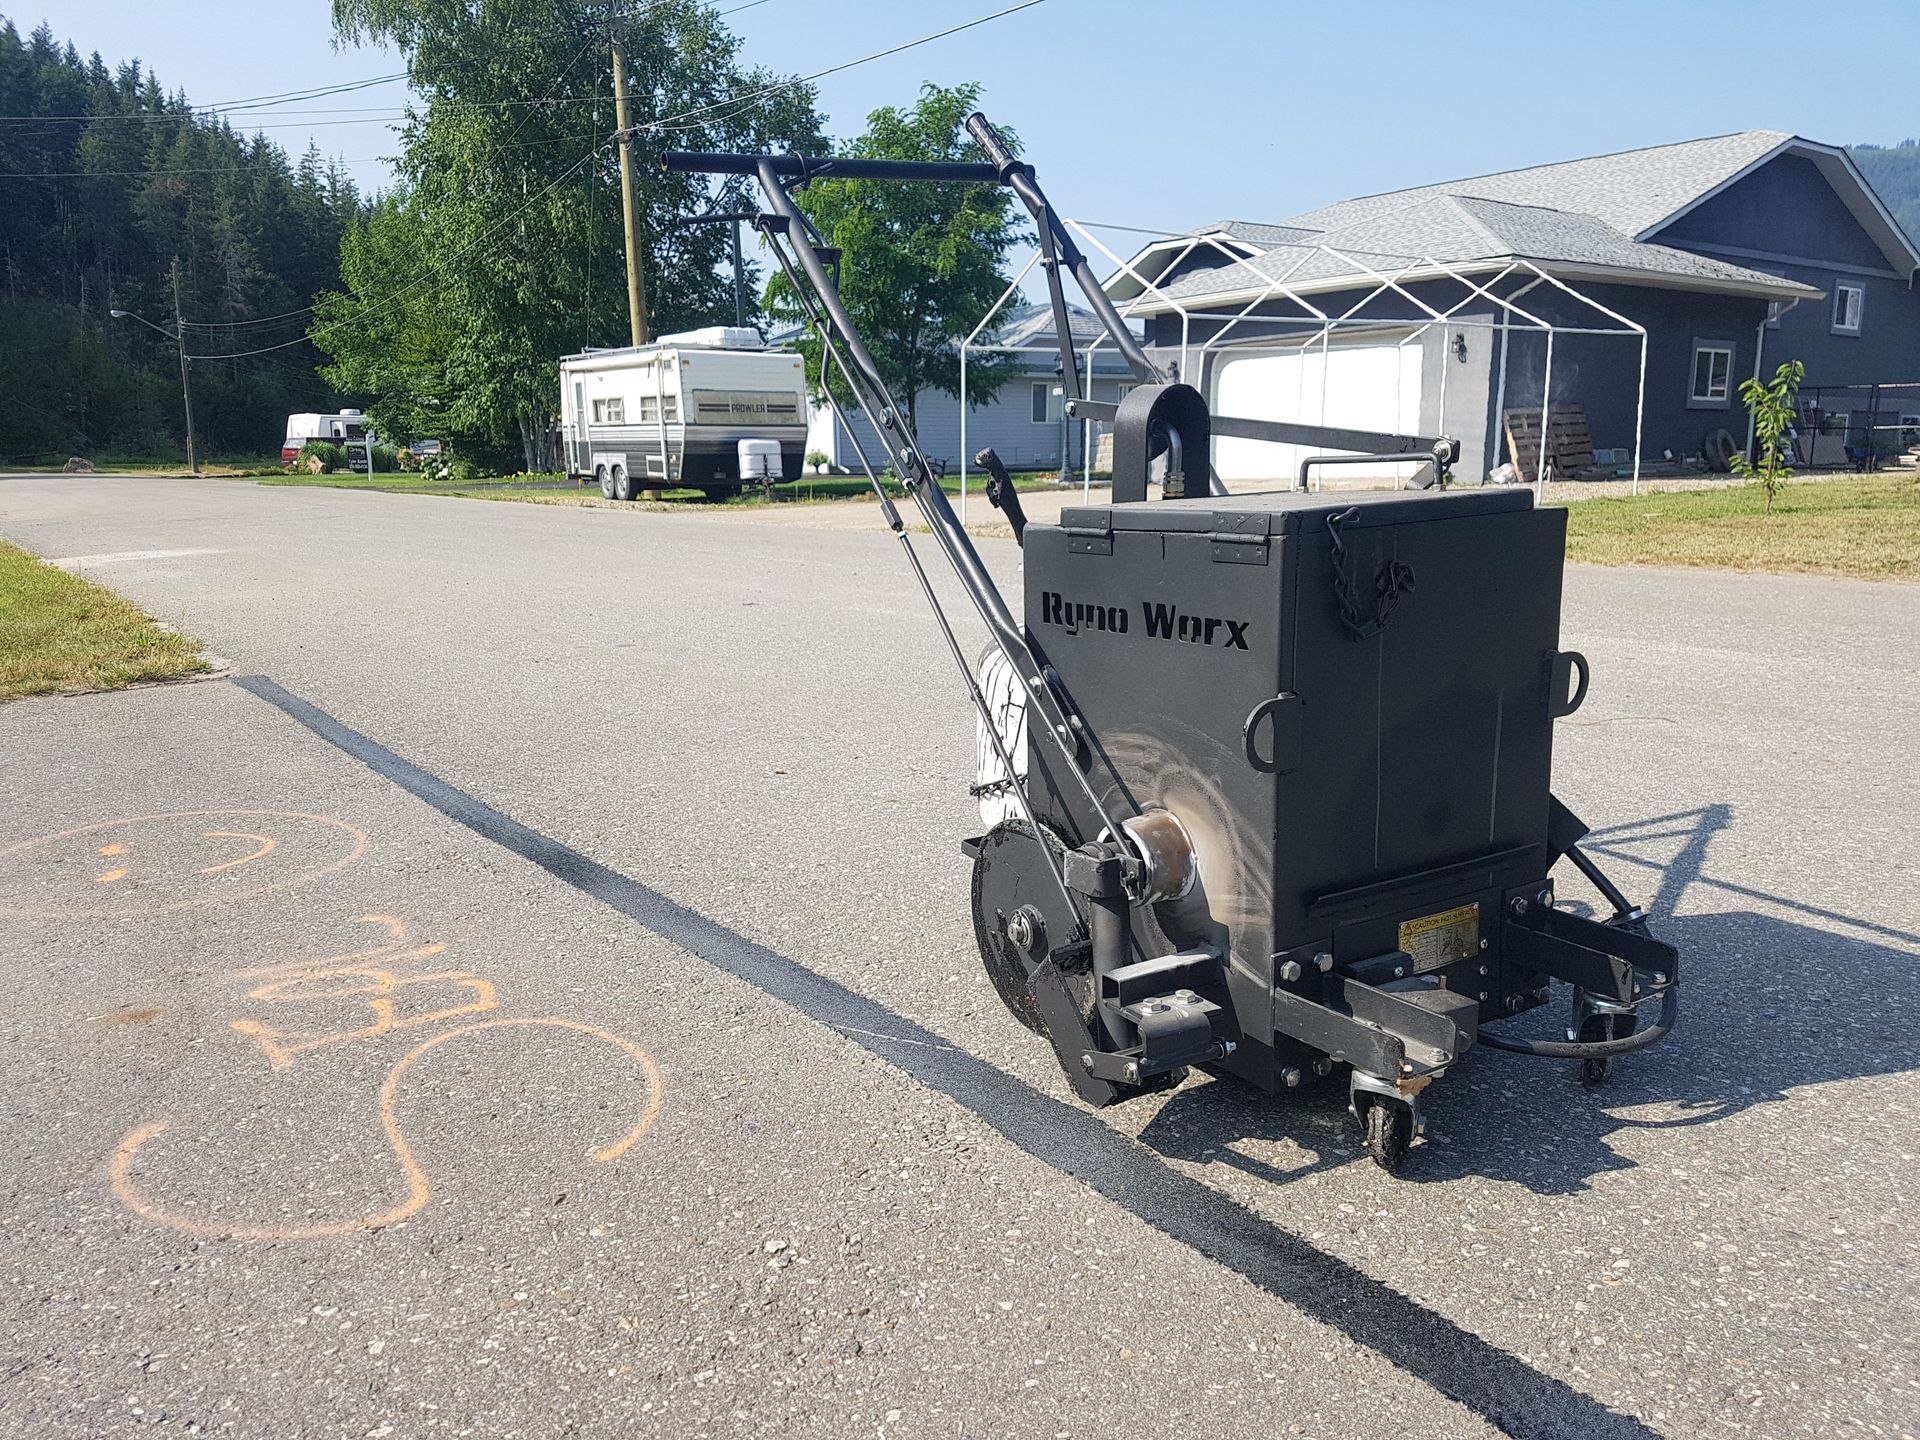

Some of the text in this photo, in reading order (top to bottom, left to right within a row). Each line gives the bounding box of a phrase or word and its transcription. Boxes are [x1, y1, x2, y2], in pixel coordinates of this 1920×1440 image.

[731, 403, 766, 413] PROWLER
[1042, 591, 1249, 650] Ryno Worx
